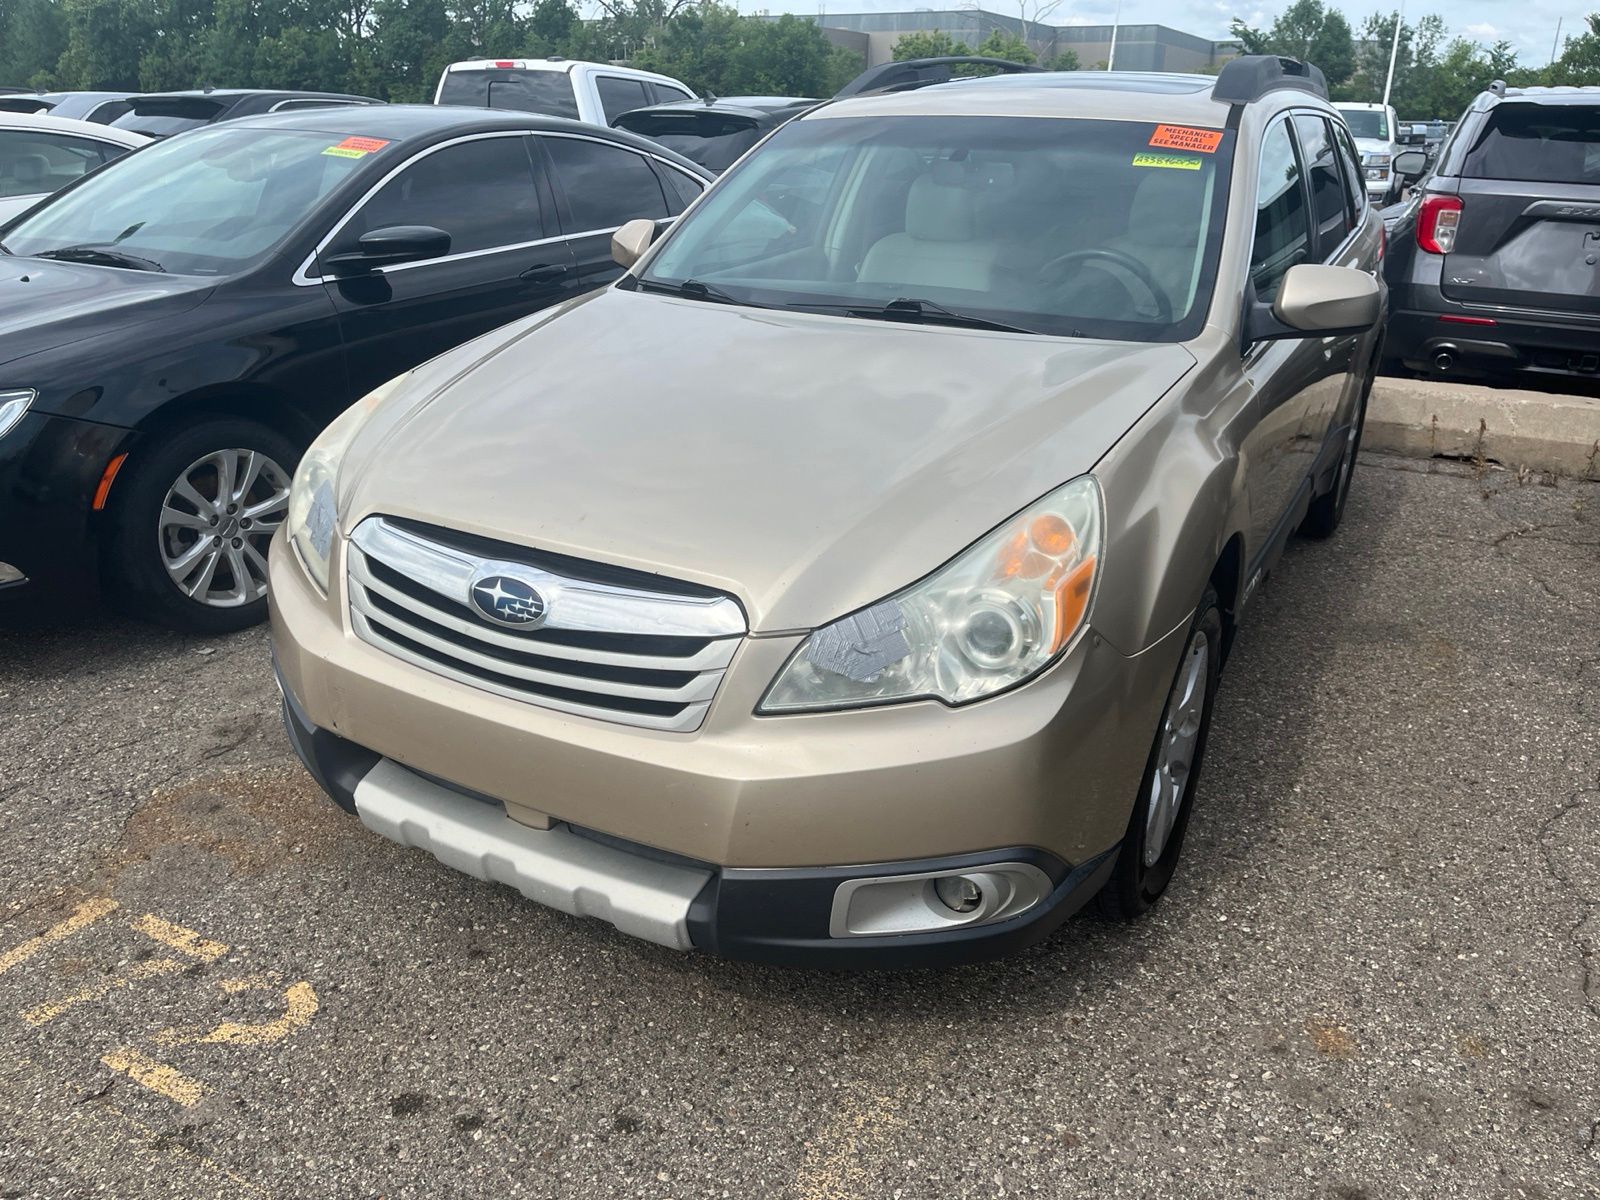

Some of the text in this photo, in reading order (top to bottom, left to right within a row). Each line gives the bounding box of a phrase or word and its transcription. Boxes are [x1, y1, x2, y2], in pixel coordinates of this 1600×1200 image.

[1164, 127, 1215, 139] MECHANICS
[1169, 133, 1204, 143] SPECIAL
[1170, 140, 1214, 151] MANAGER
